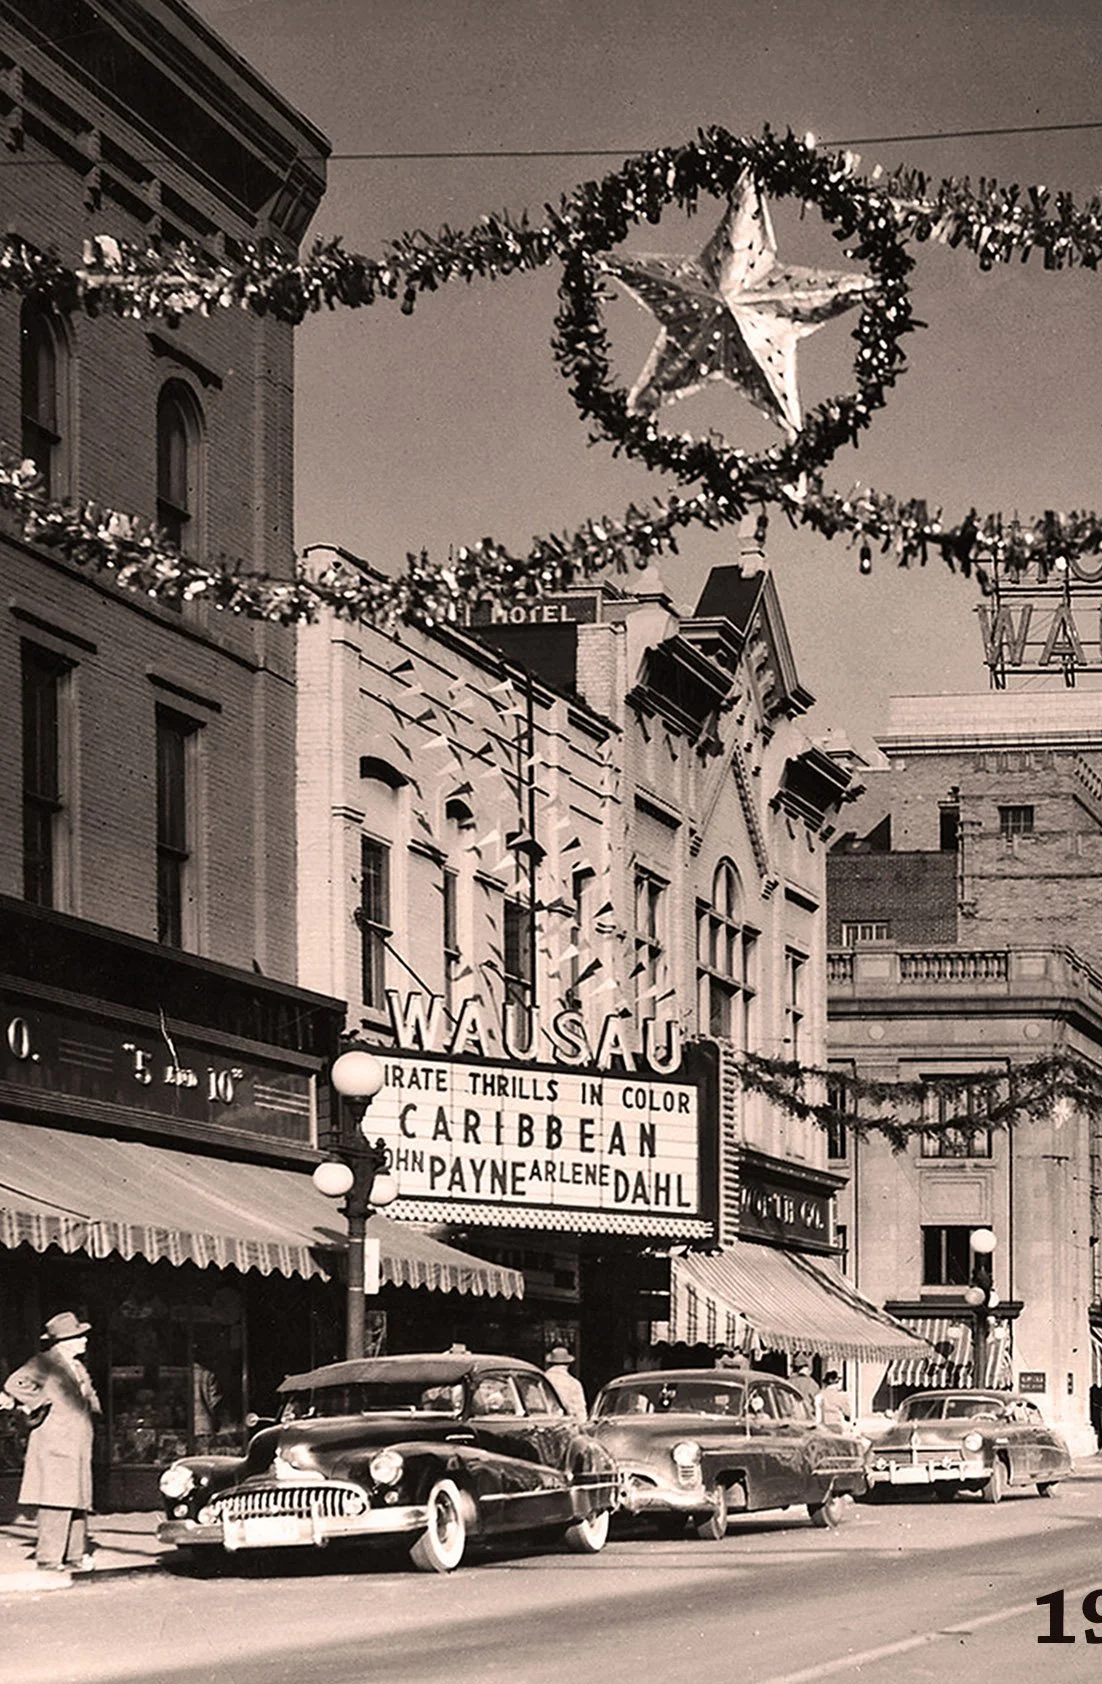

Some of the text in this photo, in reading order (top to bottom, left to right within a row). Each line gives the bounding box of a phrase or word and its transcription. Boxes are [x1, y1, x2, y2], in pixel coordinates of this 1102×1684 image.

[385, 990, 682, 1074] WAUSAU
[384, 1064, 690, 1113] IRATE THRILLS IN COLOR
[400, 1103, 656, 1158] CARIBBEAN
[382, 1147, 691, 1207] OHN PAYNE ARLENE DAHL
